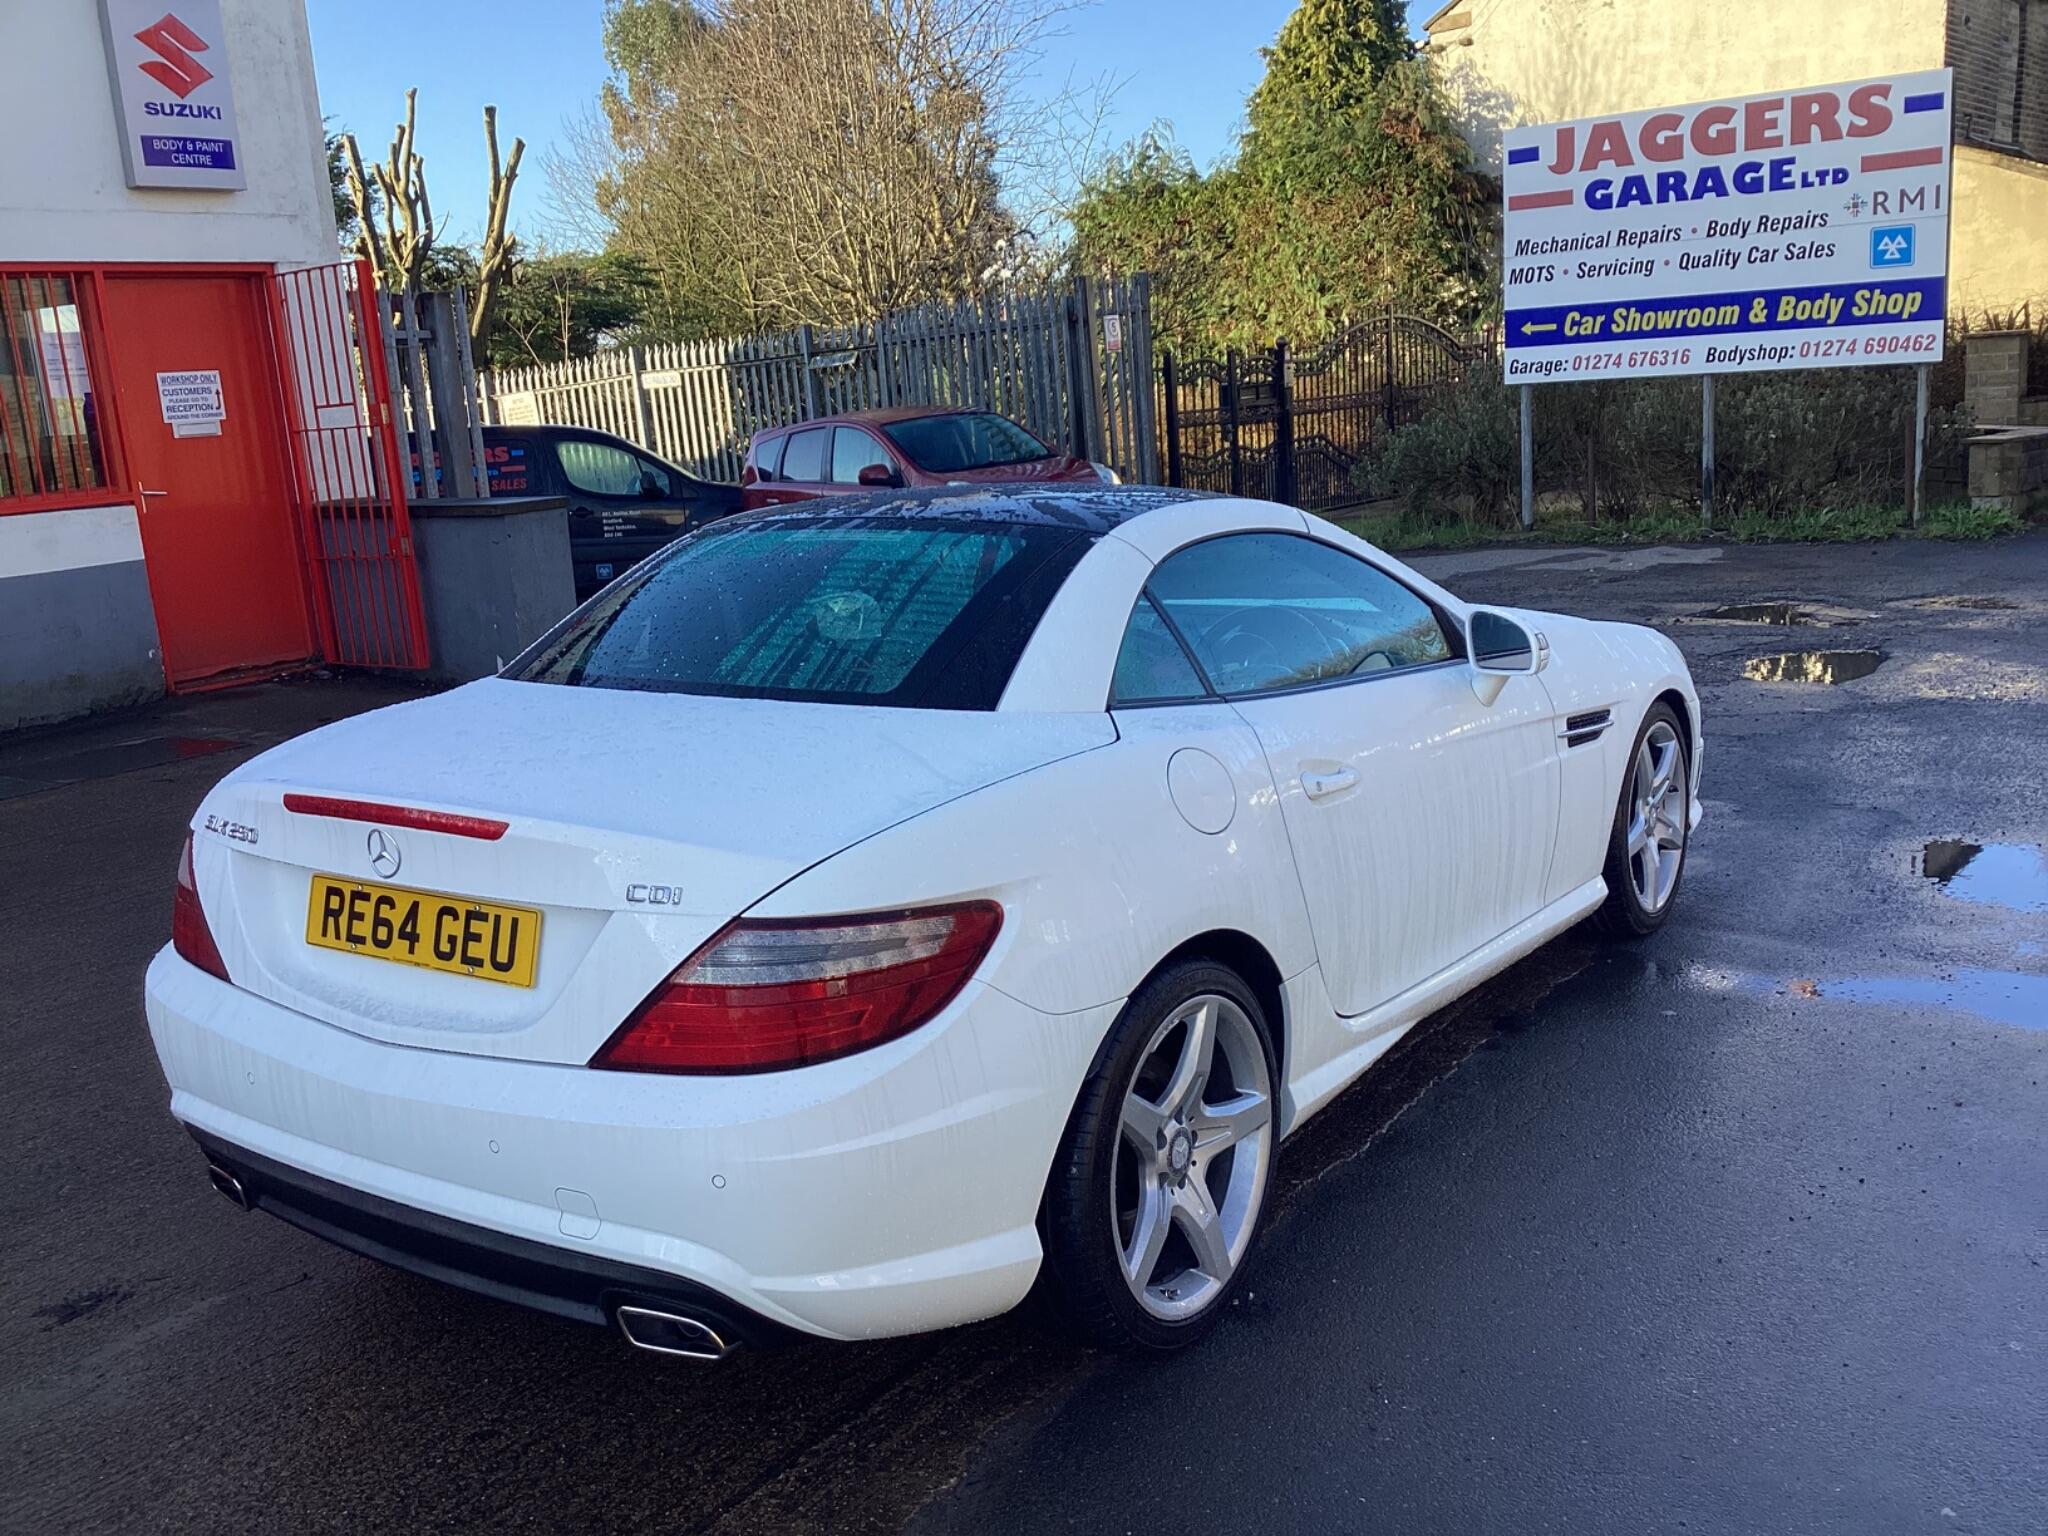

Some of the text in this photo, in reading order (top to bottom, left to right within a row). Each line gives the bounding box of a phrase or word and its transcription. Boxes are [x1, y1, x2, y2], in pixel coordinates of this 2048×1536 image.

[144, 102, 222, 120] SUZUKI
[1547, 84, 1893, 175] JAGGERS
[153, 139, 224, 153] BODY & PAINT
[171, 152, 213, 166] CENTRE
[1584, 156, 1850, 210] GARAGE LTD
[1872, 184, 1941, 216] RMI
[1514, 210, 1830, 257] Mechanical Repairs Body Repairs
[1509, 240, 1837, 286] MOTS Servicing Quality Car Sales
[1564, 288, 1923, 337] Car Showroom & Body Shop
[1509, 333, 1937, 376] Garage: 01274 676316 Bodyshop: 01274 690462
[160, 374, 217, 385] WORKSHOP ONLY
[162, 387, 212, 397] CUSTOMERS
[166, 403, 214, 413] RECEPTION
[490, 478, 528, 492] SALES
[626, 884, 684, 906] CDI
[321, 885, 519, 973] RE64 GEU
